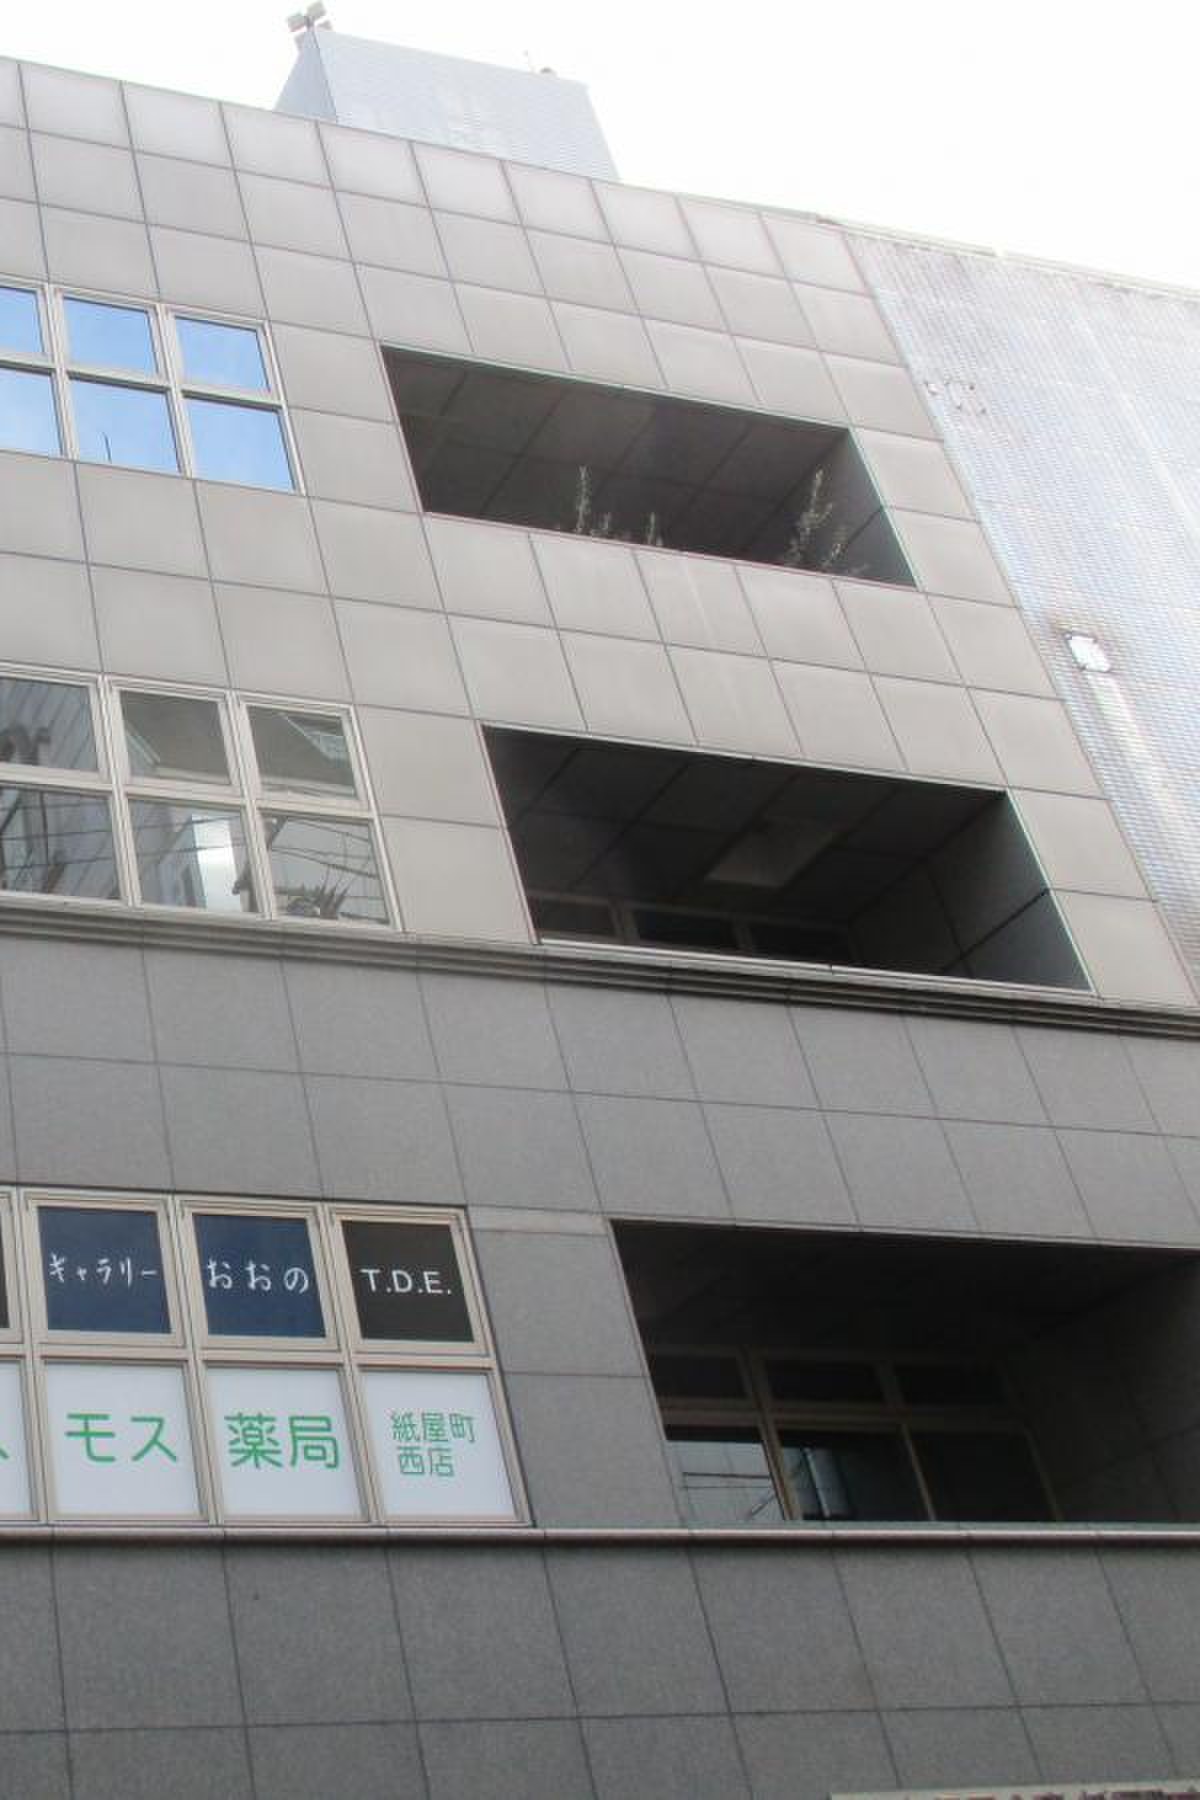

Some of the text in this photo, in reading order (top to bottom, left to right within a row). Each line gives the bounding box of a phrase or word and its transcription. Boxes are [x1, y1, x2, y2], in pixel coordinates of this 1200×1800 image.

[361, 1267, 453, 1296] T.D.E.
[390, 1411, 477, 1444] 紙屋町
[396, 1446, 455, 1478] 西店
